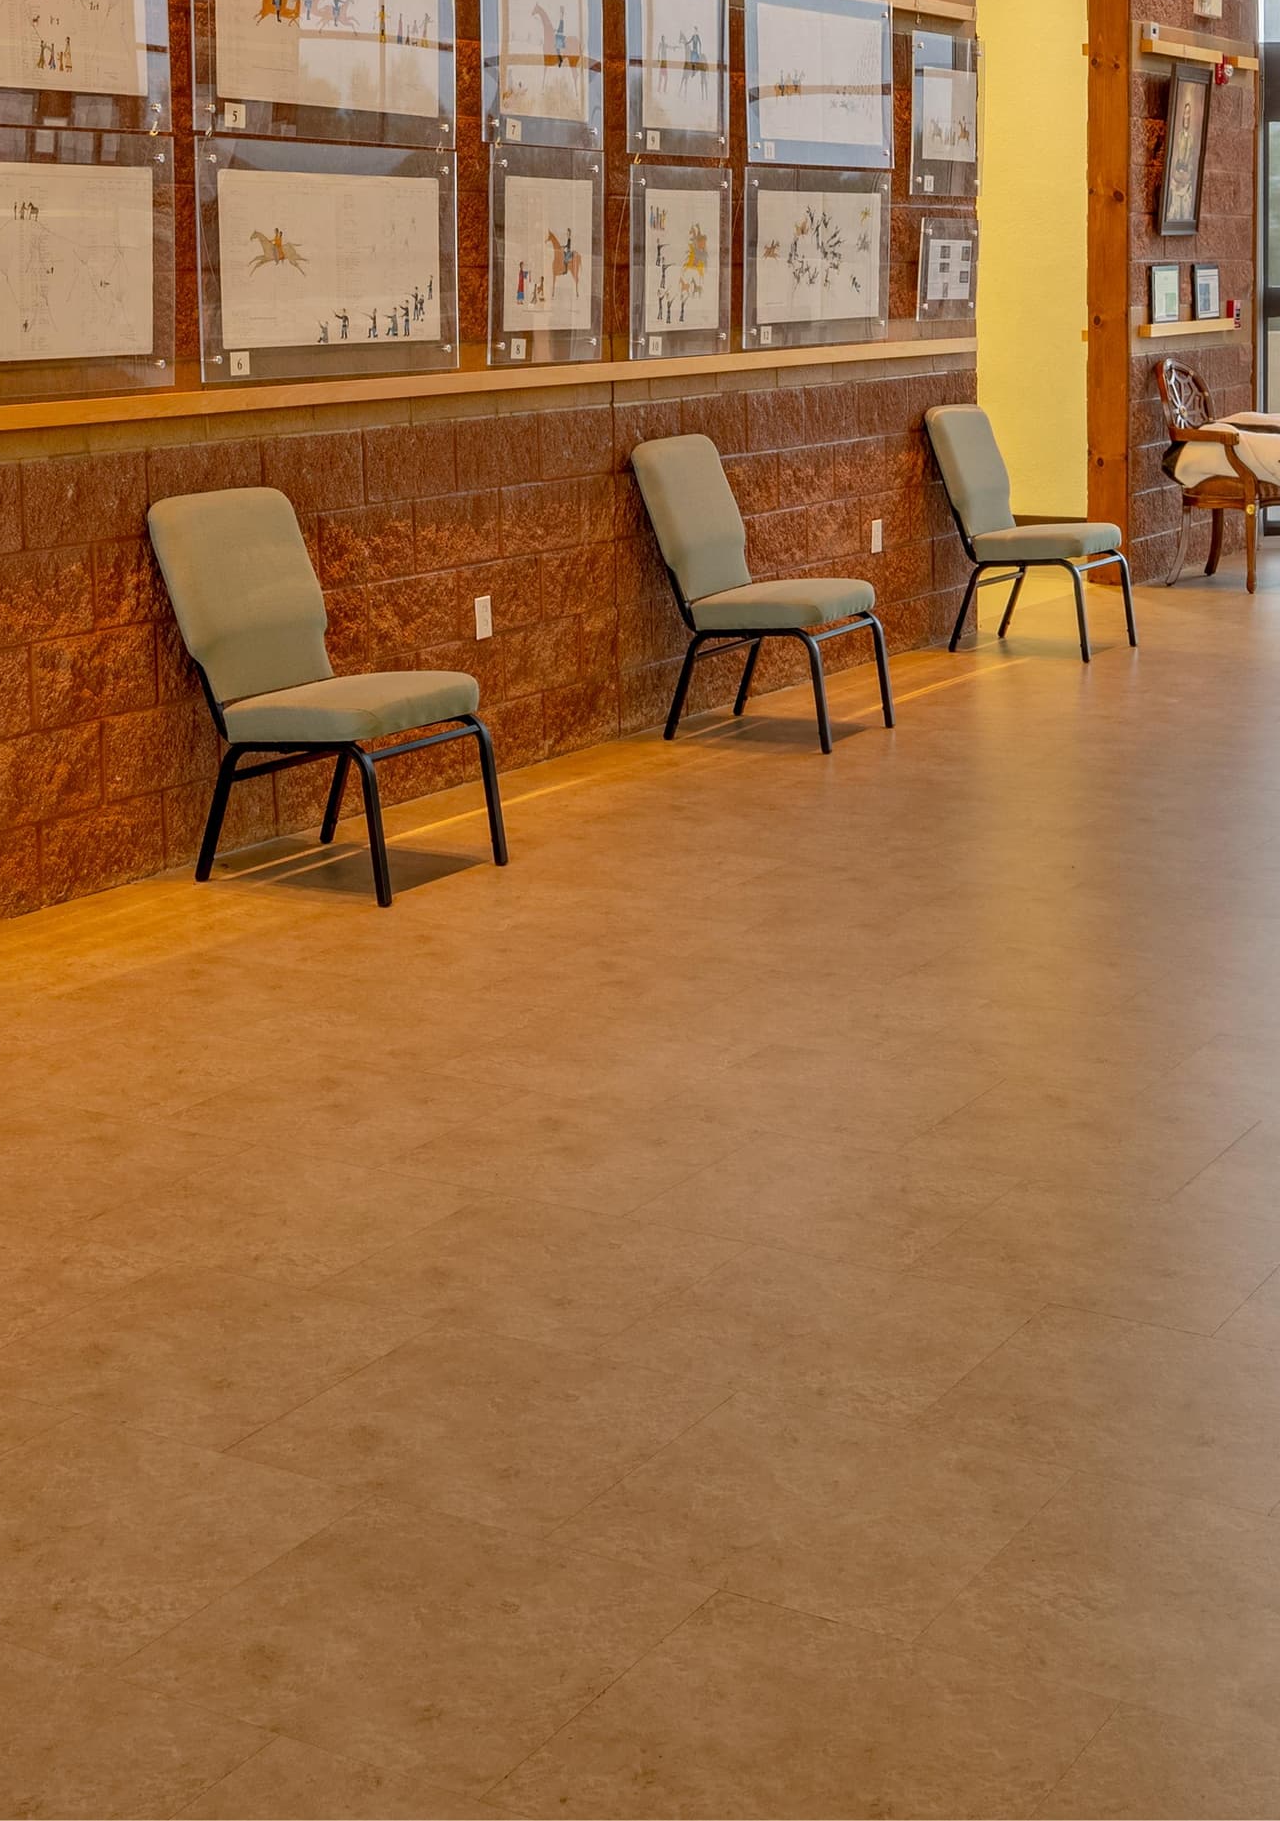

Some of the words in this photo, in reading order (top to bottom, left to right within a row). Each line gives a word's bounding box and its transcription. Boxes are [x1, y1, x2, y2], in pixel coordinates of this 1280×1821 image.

[232, 110, 238, 122] 5
[511, 125, 517, 136] 7
[237, 358, 243, 370] 6
